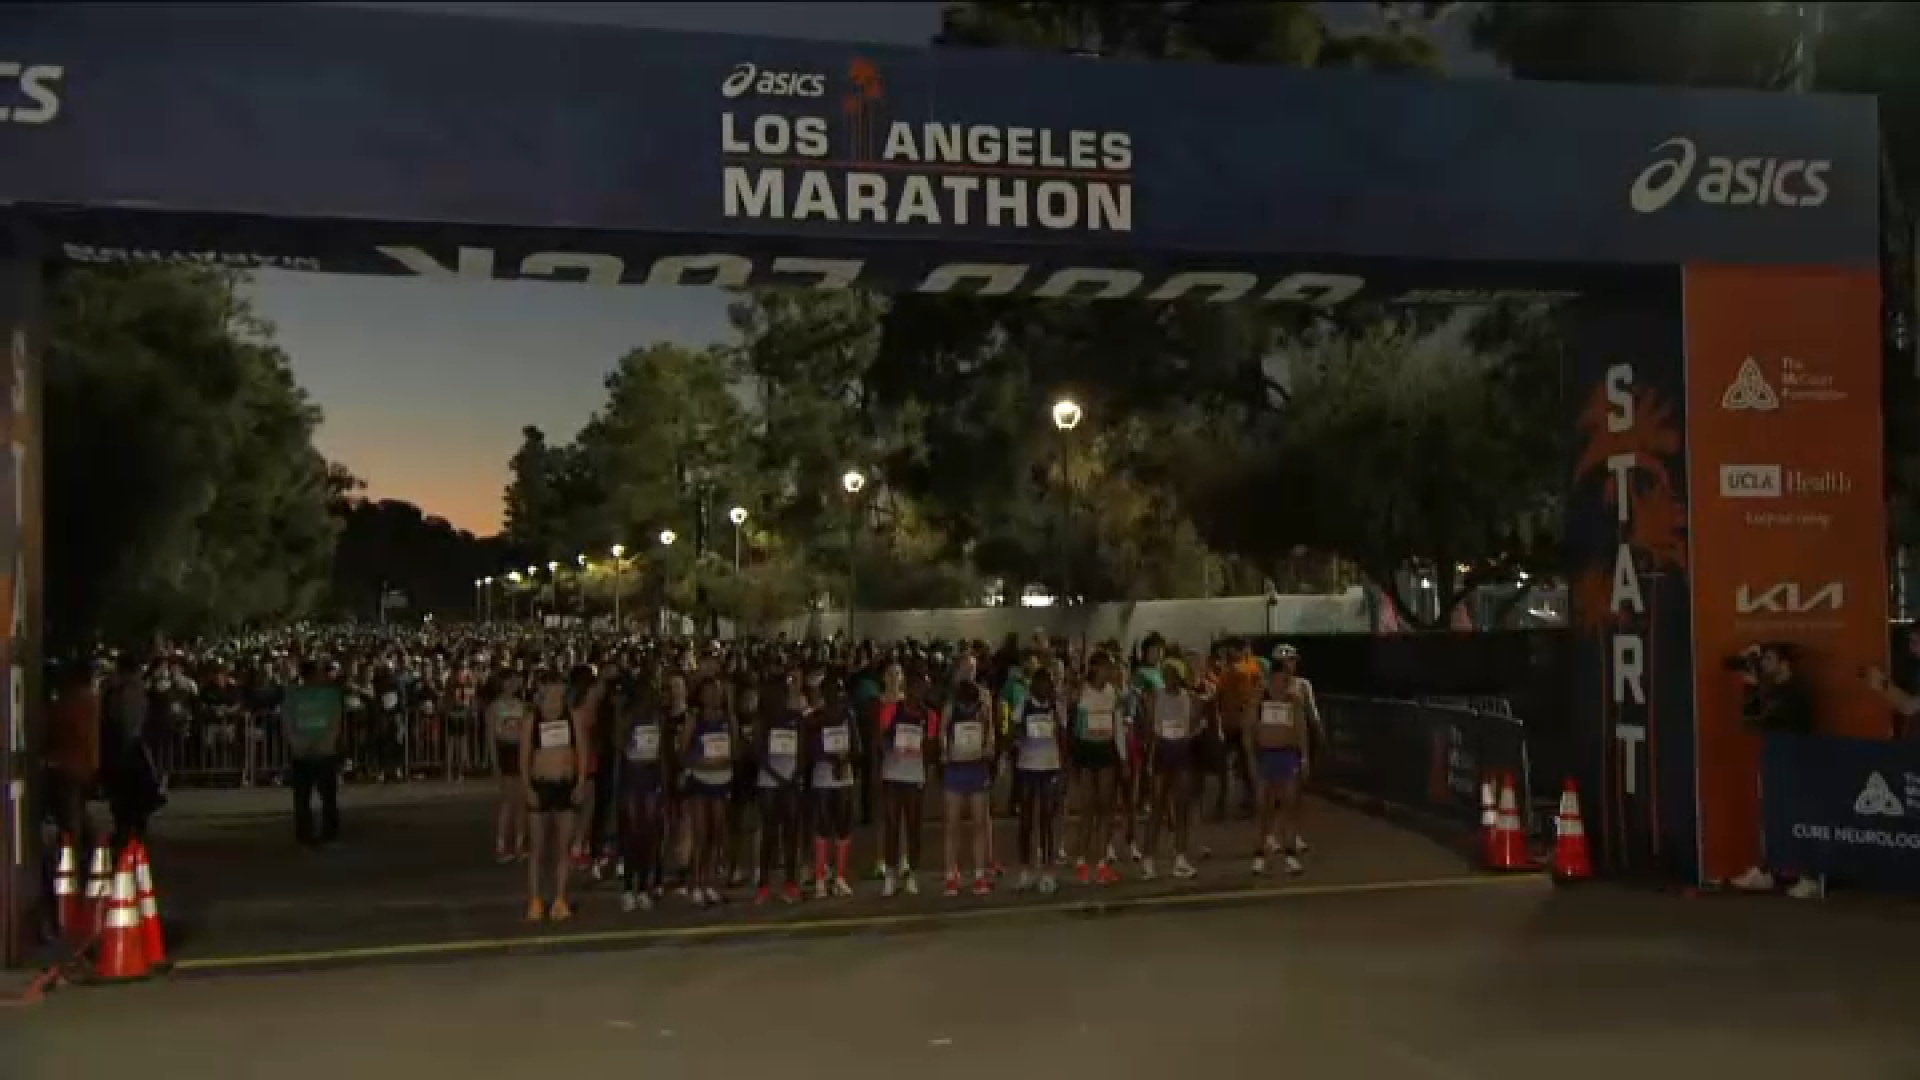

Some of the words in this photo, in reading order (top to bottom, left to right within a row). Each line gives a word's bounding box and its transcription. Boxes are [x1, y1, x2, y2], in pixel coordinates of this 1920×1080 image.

[757, 69, 826, 98] asics
[721, 111, 829, 156] LOS
[882, 121, 1132, 170] ANGELES
[721, 166, 1132, 231] MARATHON
[1697, 155, 1832, 207] asics
[1606, 362, 1646, 796] START
[1735, 582, 1844, 613] KIA
